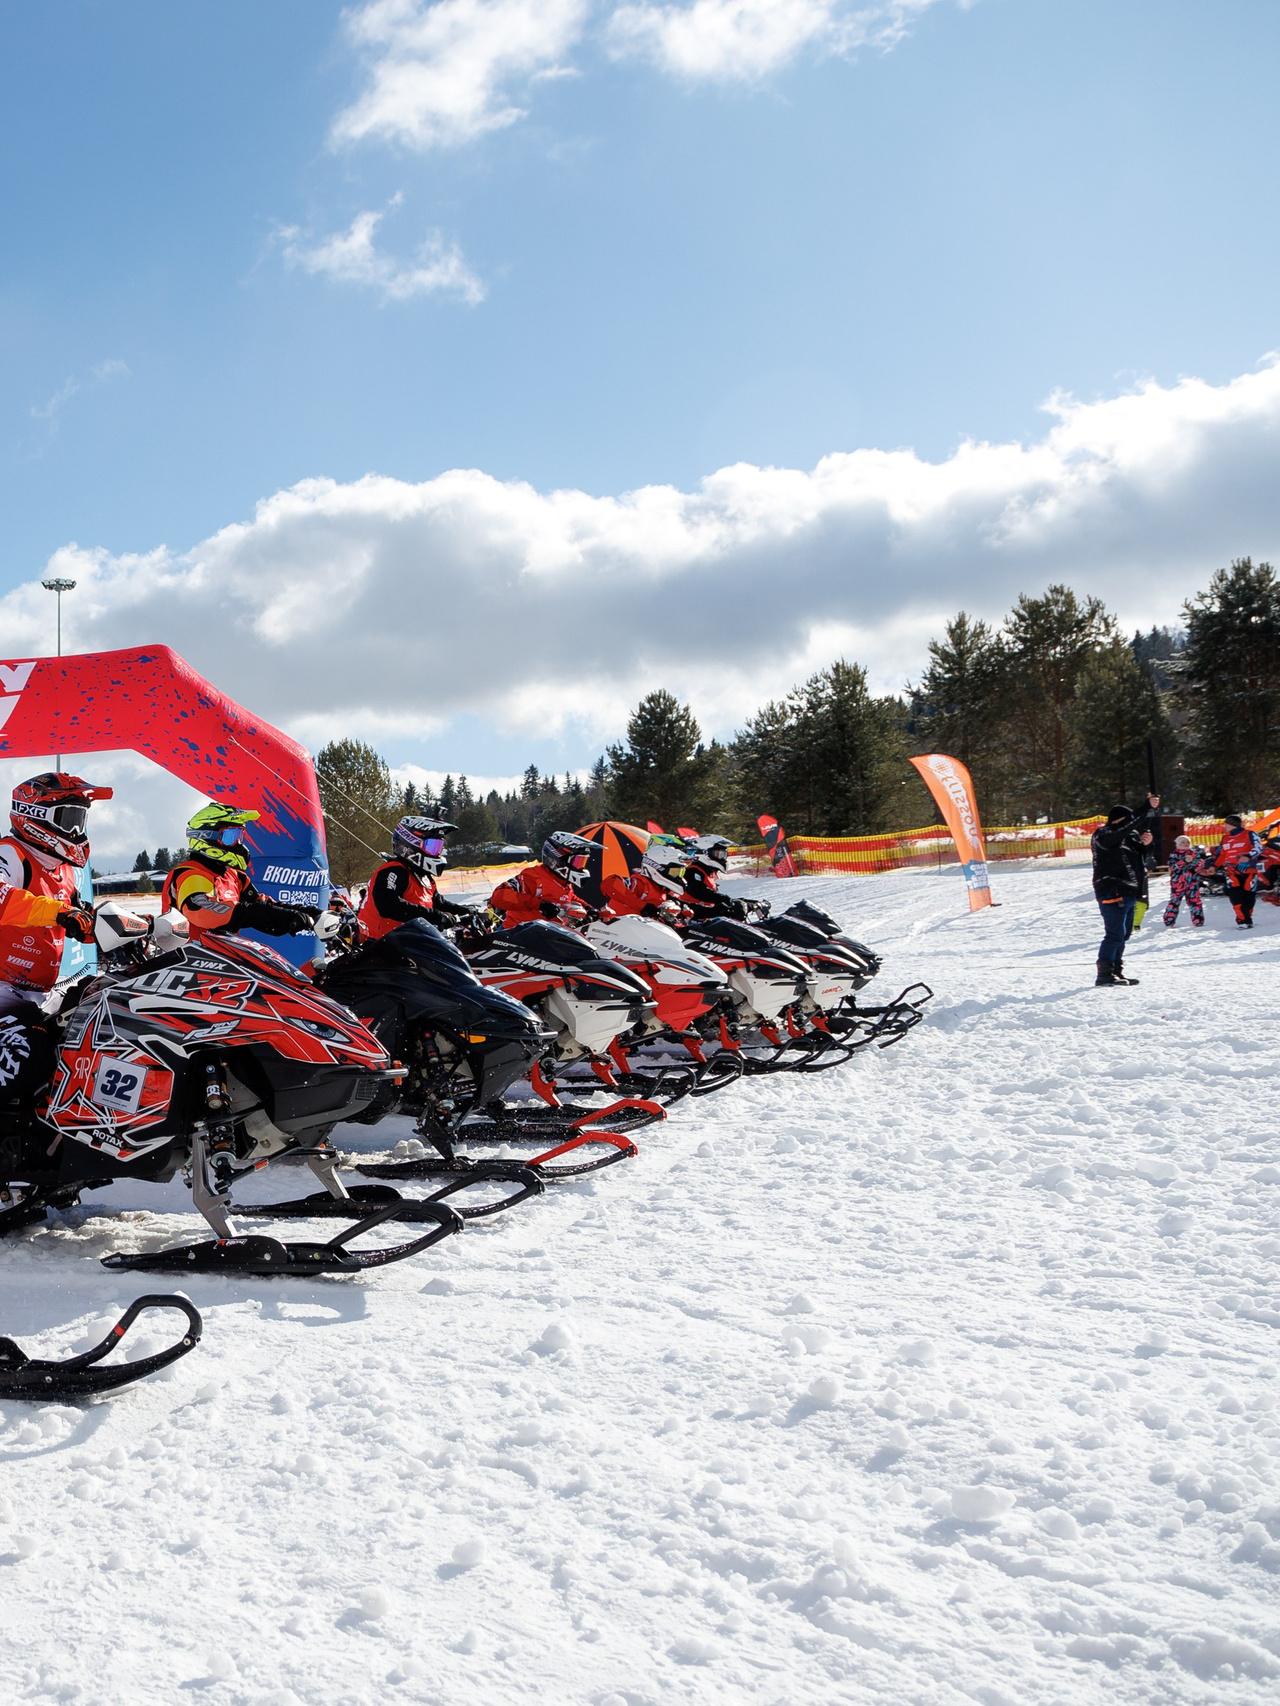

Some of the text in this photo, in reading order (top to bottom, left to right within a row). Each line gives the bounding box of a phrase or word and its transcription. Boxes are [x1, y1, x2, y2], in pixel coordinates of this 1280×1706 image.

[18, 804, 46, 818] FXR
[11, 942, 42, 955] CFMOTO
[600, 940, 638, 956] LYNX
[699, 941, 736, 955] LYNX
[190, 960, 228, 970] LYNX
[506, 951, 551, 970] LYNX
[100, 1069, 138, 1101] 32
[92, 1129, 124, 1147] ROTAX
